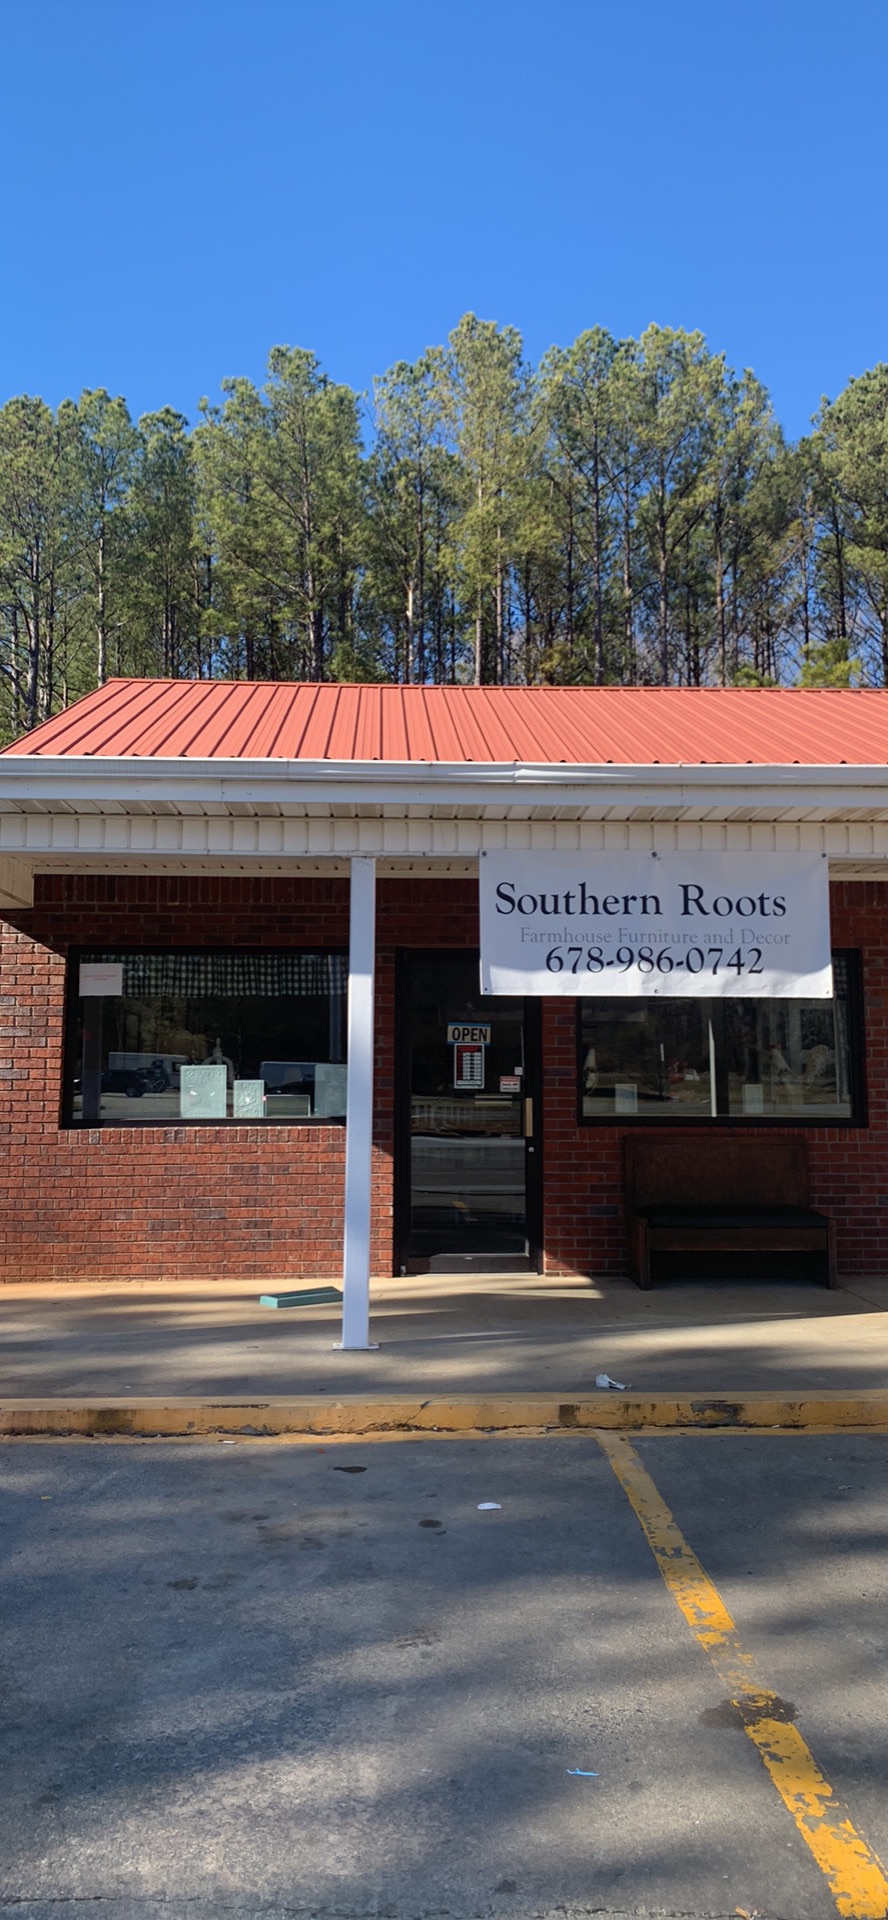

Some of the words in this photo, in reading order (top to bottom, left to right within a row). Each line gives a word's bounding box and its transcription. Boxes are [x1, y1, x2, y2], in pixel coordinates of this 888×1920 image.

[495, 882, 664, 915] Southern
[678, 883, 787, 917] Roots
[520, 927, 612, 943] Farmhouse
[618, 928, 698, 944] Furniture
[703, 928, 734, 944] and
[741, 928, 791, 945] Decor
[545, 946, 765, 975] 678-986-0742
[452, 1027, 488, 1042] OPEN
